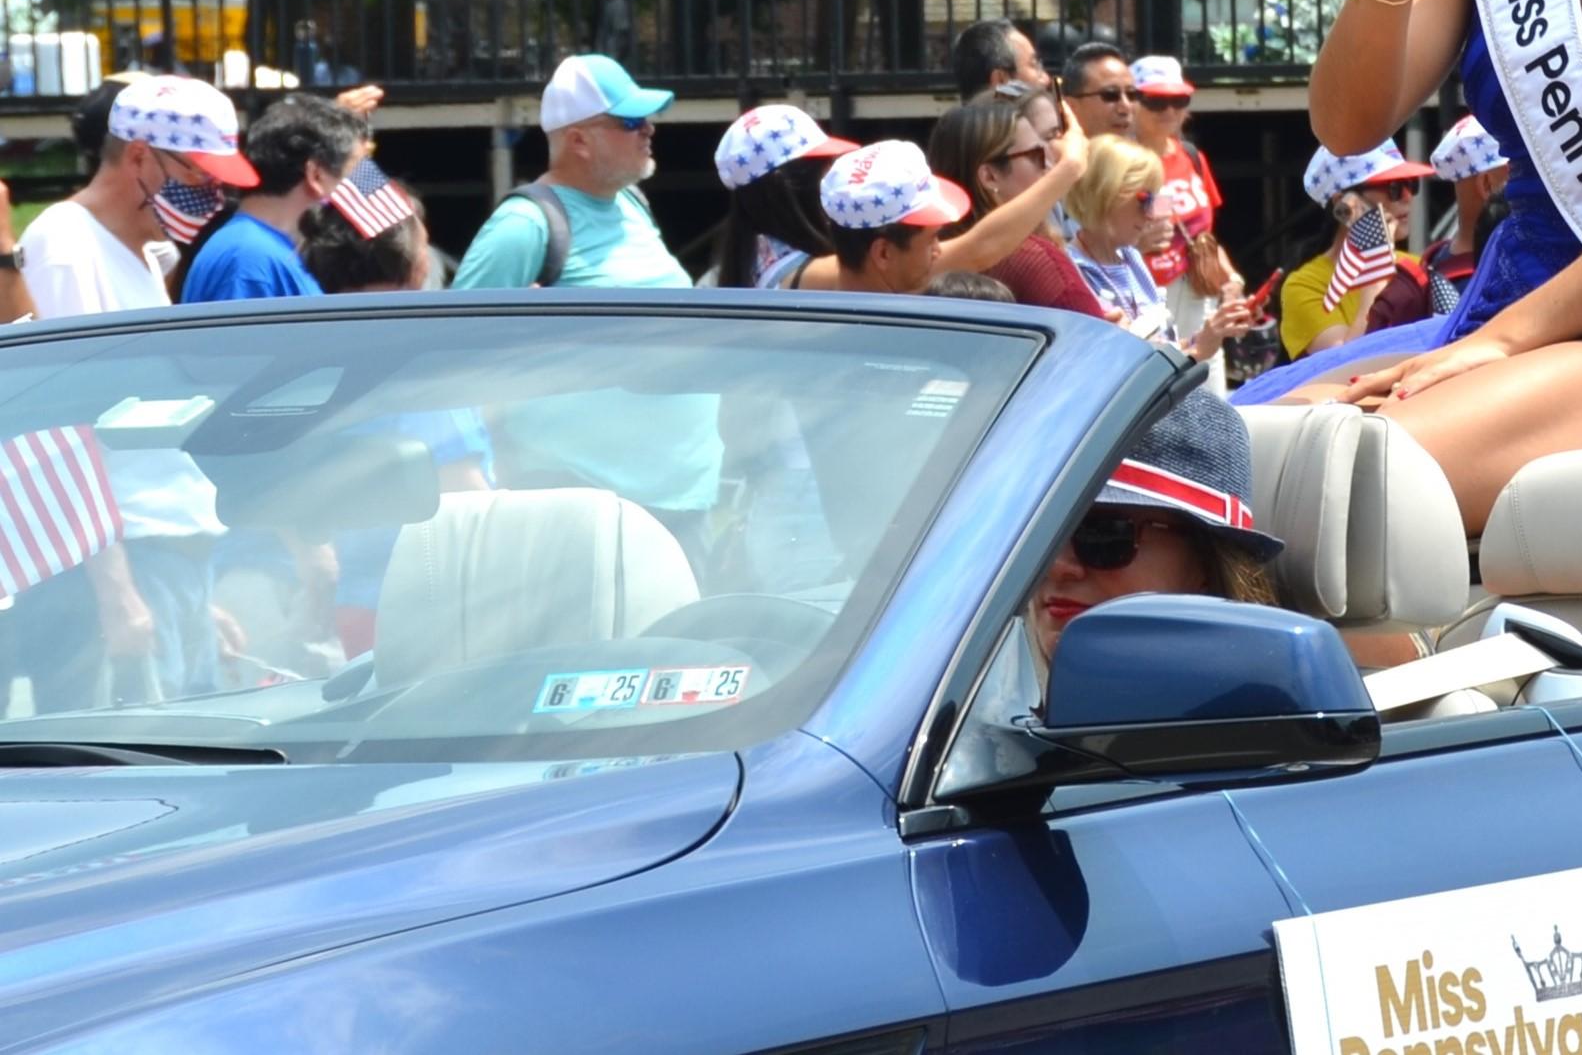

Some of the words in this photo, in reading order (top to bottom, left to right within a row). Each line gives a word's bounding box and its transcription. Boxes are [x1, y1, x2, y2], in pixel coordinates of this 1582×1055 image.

[610, 674, 640, 701] 25
[714, 670, 744, 696] 25
[1375, 949, 1487, 1039] Miss
